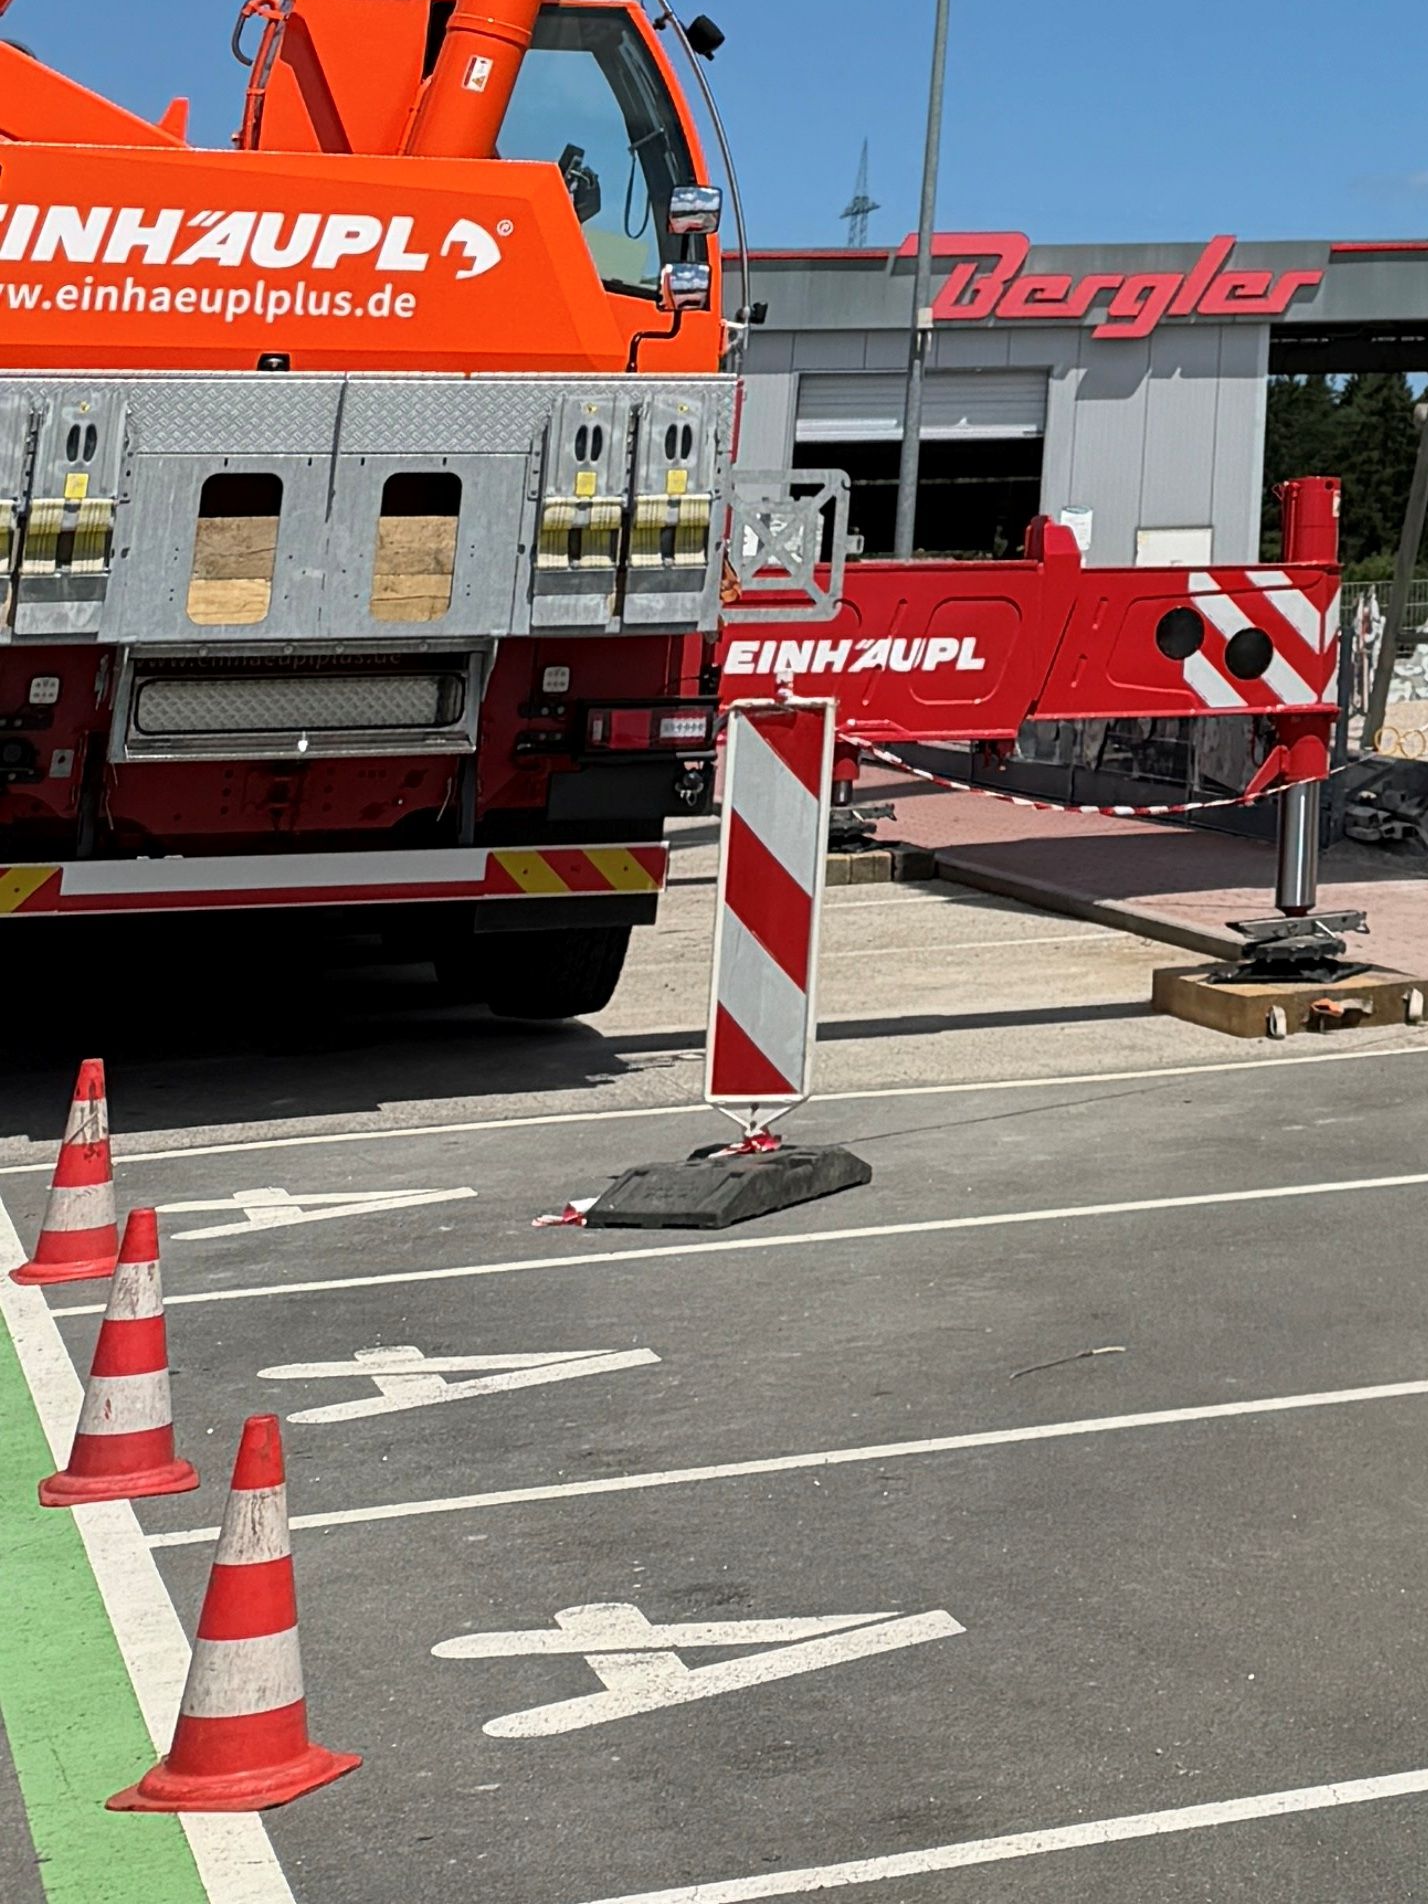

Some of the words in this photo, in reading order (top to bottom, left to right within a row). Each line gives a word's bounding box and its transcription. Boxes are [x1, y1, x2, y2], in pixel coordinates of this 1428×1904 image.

[0, 203, 430, 271] INHÄUPL
[0, 275, 416, 323] w.einhaeuplplus.de
[896, 230, 1324, 339] Bergler
[723, 636, 985, 674] EINHÄUPL
